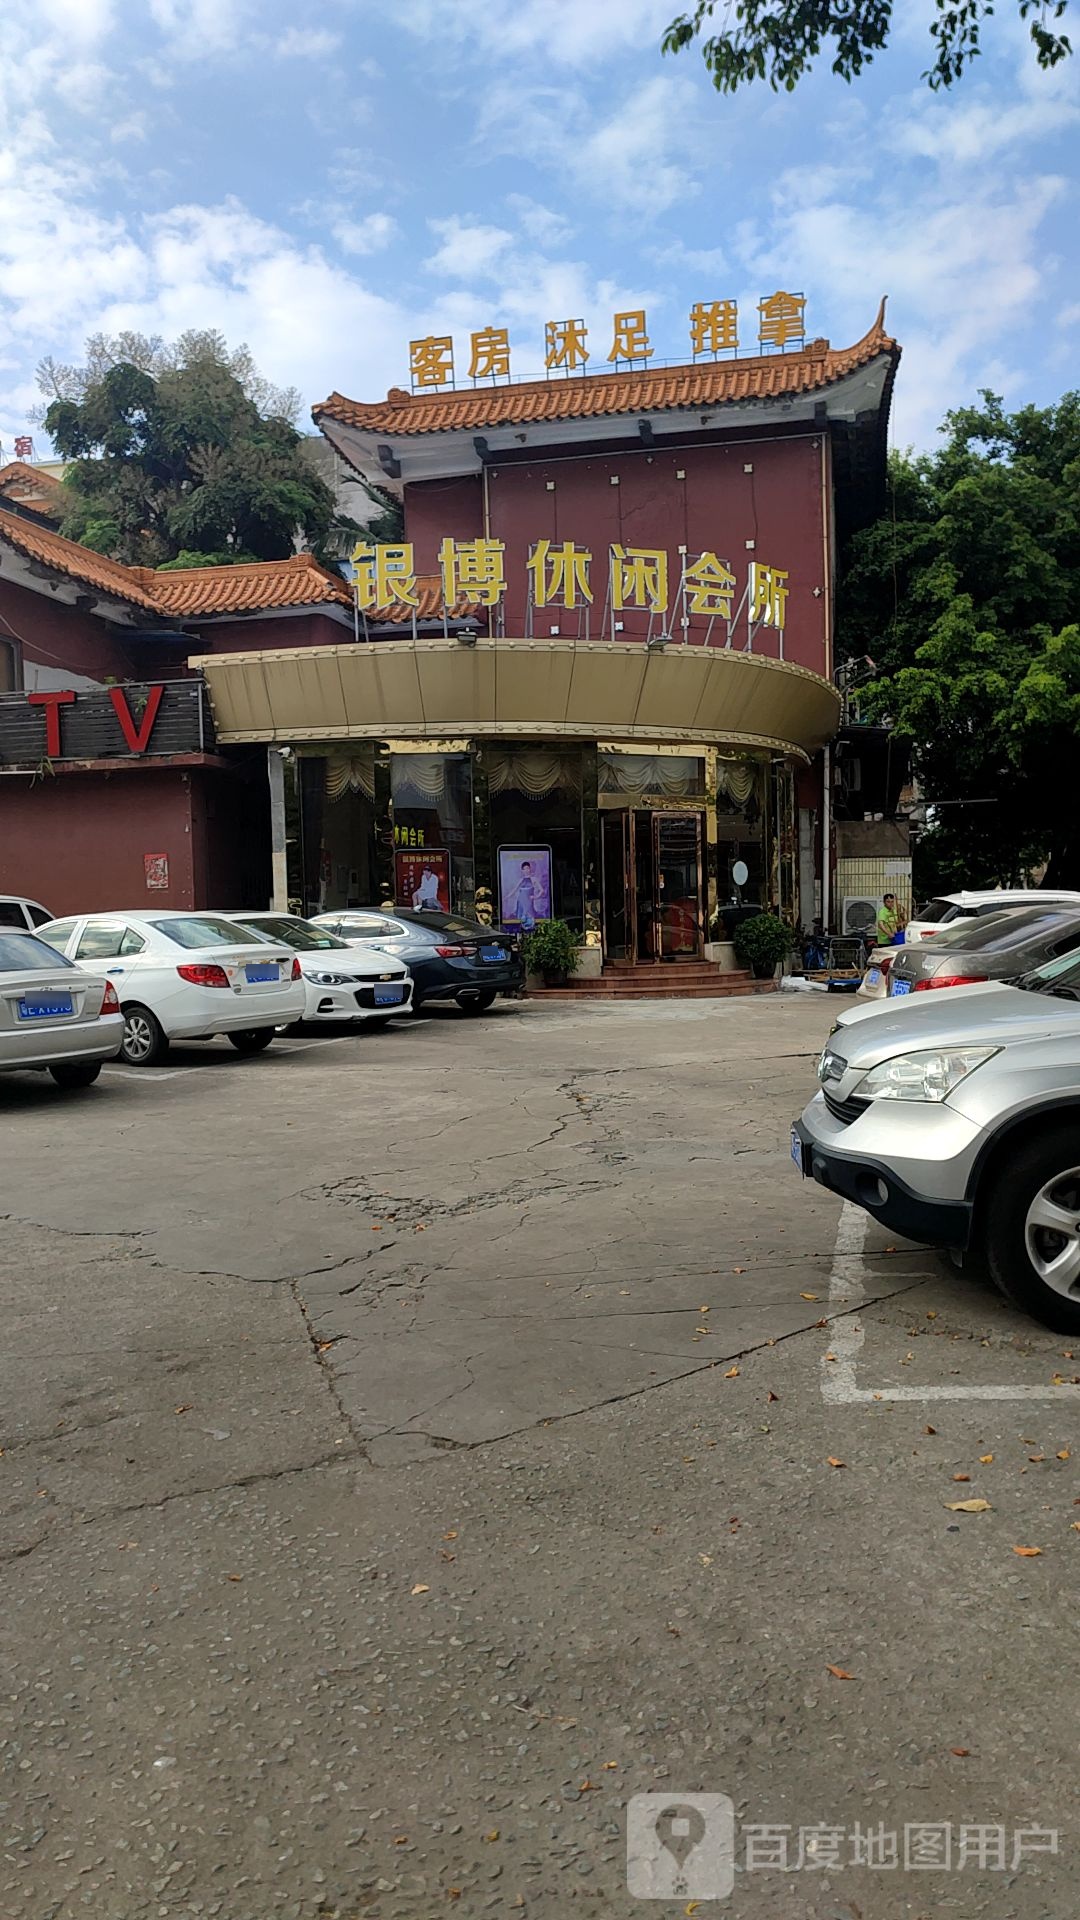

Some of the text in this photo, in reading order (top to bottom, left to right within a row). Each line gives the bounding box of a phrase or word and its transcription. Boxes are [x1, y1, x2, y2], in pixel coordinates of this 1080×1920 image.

[410, 291, 807, 388] 客房 沐足 推拿
[350, 537, 790, 629] 银博休闲会所
